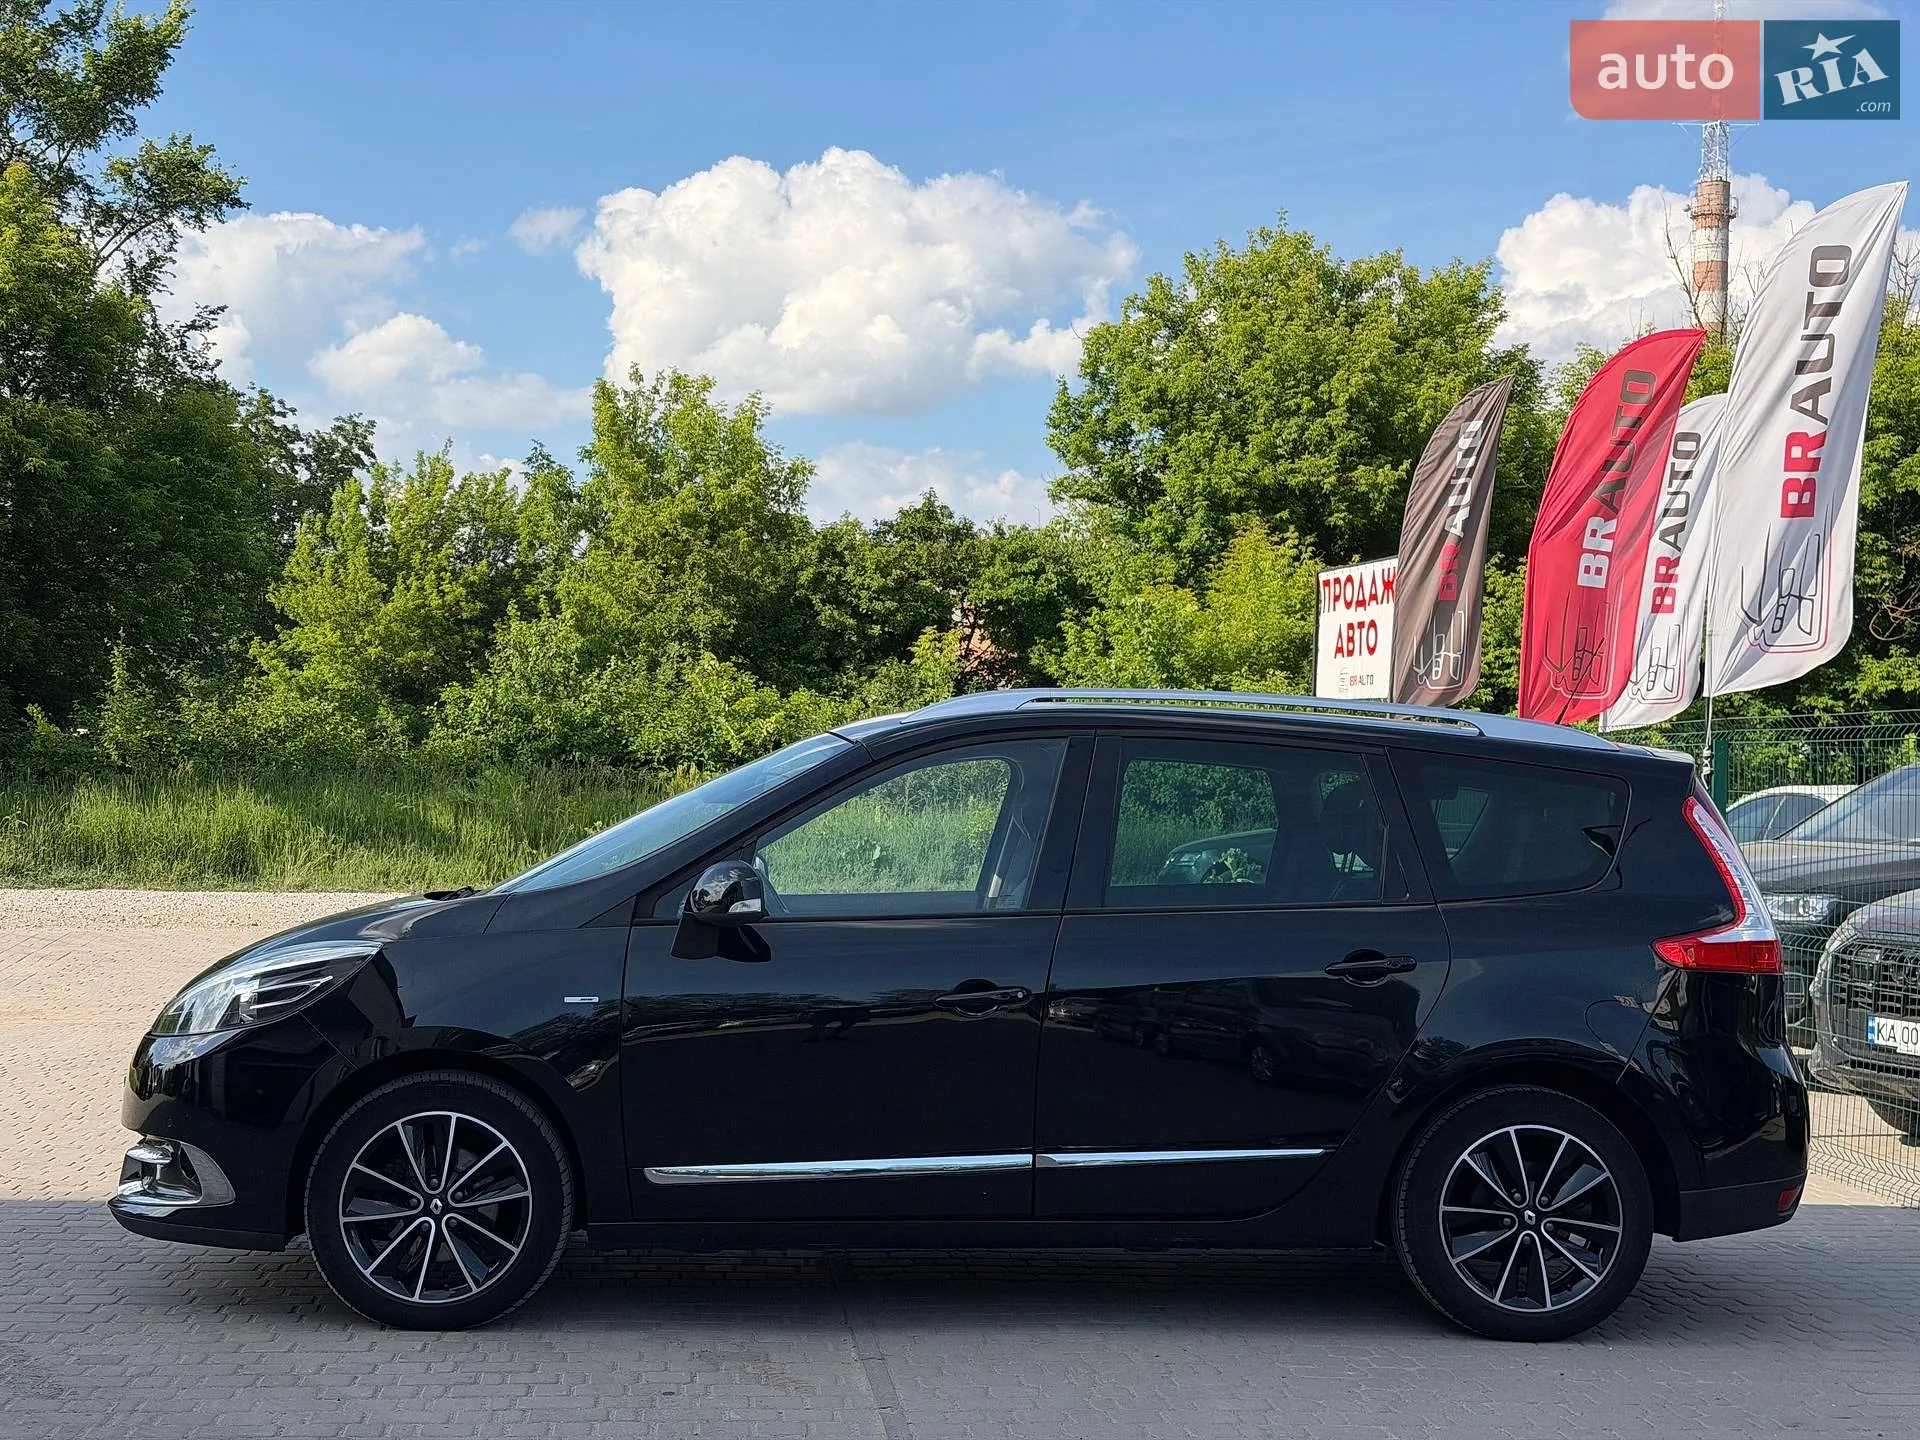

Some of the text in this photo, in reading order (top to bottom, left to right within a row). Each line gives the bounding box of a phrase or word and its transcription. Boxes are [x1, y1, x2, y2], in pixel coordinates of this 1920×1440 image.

[1780, 245, 1852, 519] BRAUTO
[1577, 369, 1657, 589] BRAUTO
[1651, 431, 1702, 614] BRAUTO
[1322, 567, 1397, 614] ПРОДАЖ
[1334, 619, 1378, 659] АВТО
[1877, 1021, 1897, 1043] KA
